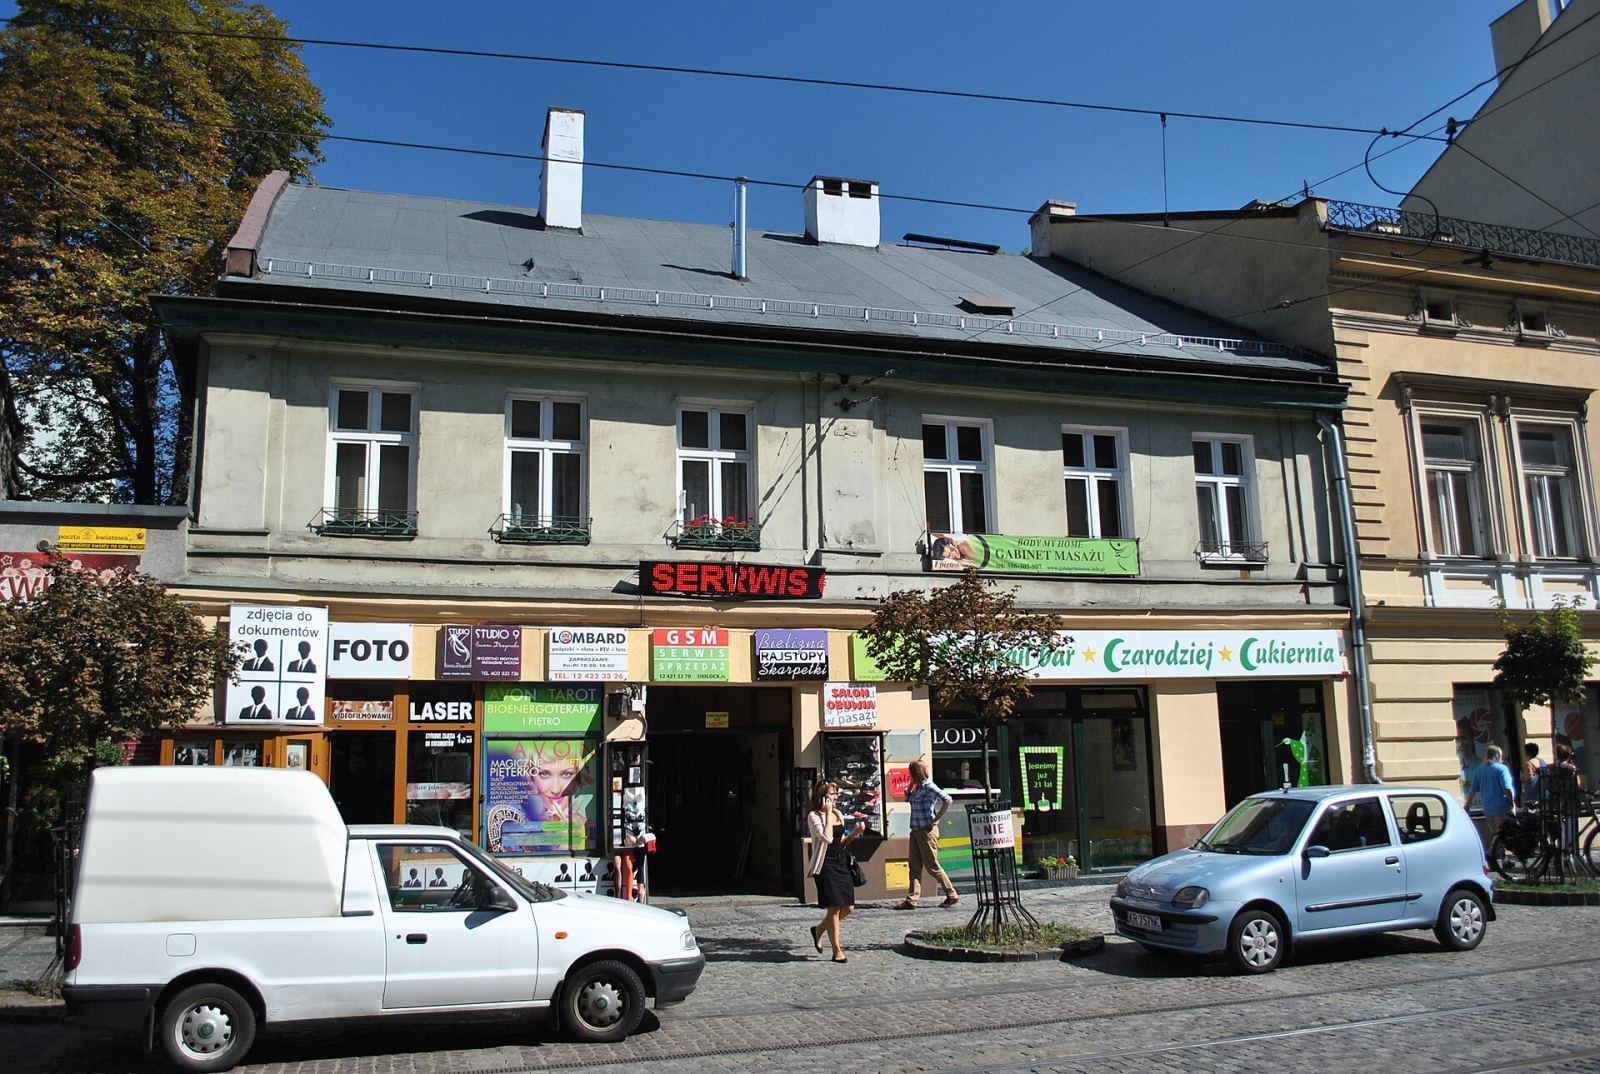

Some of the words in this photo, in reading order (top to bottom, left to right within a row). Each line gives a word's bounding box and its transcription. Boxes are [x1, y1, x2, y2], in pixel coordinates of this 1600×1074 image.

[1017, 538, 1041, 547] BODY
[1057, 540, 1083, 548] HOME
[995, 549, 1052, 560] GABINET
[1054, 549, 1105, 561] MASAŻU
[247, 608, 293, 623] zdjęcia
[297, 610, 313, 622] do
[238, 624, 319, 638] dokumentów
[475, 629, 509, 640] STUDIO
[512, 629, 520, 640] 9
[666, 629, 717, 645] GSM
[552, 630, 626, 645] LOMBARD
[758, 632, 826, 652] Bielizna
[332, 638, 410, 662] FOTO
[659, 648, 725, 658] SERWIS
[761, 651, 824, 661] RAJSTOPY
[1103, 637, 1214, 673] Czarodziej
[1239, 637, 1335, 671] Cukiernia
[659, 662, 726, 671] SPRZEDAŻ
[758, 661, 827, 680] Skarpetki
[489, 688, 537, 701] AVON
[547, 688, 597, 701] TAROT
[831, 688, 870, 699] SALON
[410, 701, 473, 720] LASER
[487, 704, 597, 714] BIOENERGOTERAPIA
[826, 700, 876, 710] OBUWIA
[333, 712, 392, 720] VIDEOFILMOWANIE
[528, 716, 561, 727] PIĘTRO
[490, 759, 543, 769] MAGICZNE
[983, 823, 1004, 835] NIE
